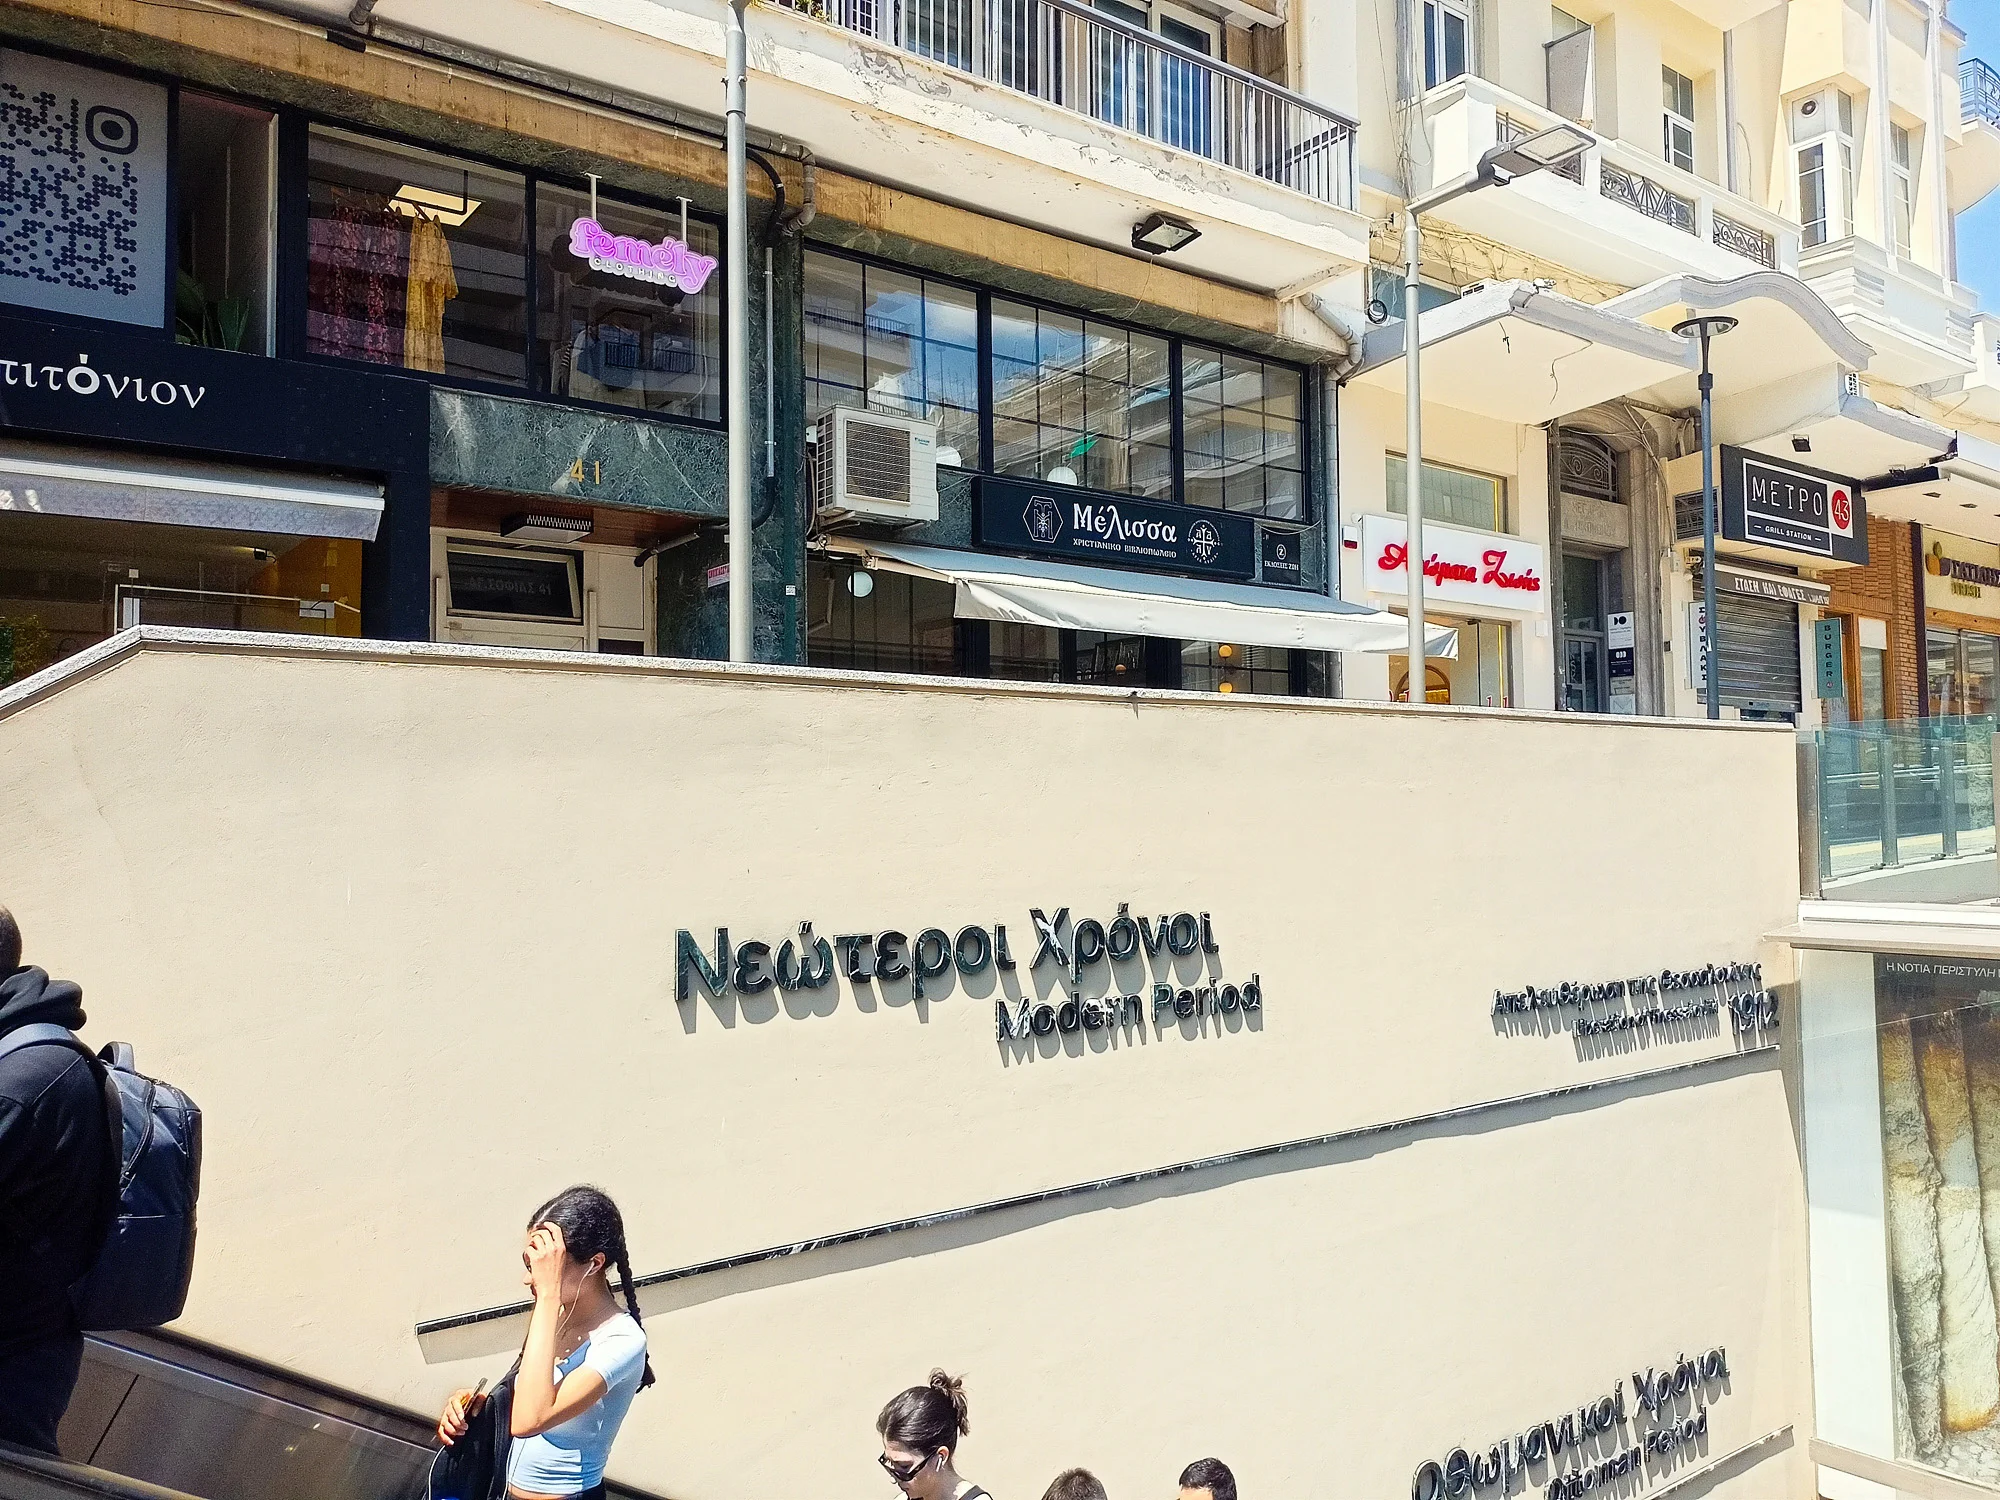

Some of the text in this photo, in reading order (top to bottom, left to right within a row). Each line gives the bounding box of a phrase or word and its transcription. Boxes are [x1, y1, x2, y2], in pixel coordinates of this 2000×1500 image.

[575, 220, 715, 290] femély
[593, 257, 677, 283] CLOTHING
[570, 458, 600, 485] 41
[1751, 476, 1823, 516] ΜΕΤΡΟ
[1834, 498, 1850, 521] 43
[1073, 503, 1178, 543] Μέλισσα
[1765, 525, 1812, 541] GRILL STATION
[1378, 541, 1541, 592] Αώματα Ζωής
[1734, 577, 1760, 593] ΣΤΑΣΗ
[1762, 581, 1777, 596] ΚΑΙ
[1824, 624, 1834, 678] BURGER
[674, 902, 1220, 1001] Νεώτεροι Χρόνοι
[1886, 962, 1895, 971] Η
[1897, 962, 1931, 974] ΝΟΤΙΑ
[1933, 964, 1996, 978] ΠΕΡΙΣΤΥΛΗ
[995, 973, 1261, 1042] Modern Period
[1632, 1345, 1731, 1423] Χρόνοι
[1543, 1403, 1709, 1500] Ottoman Period
